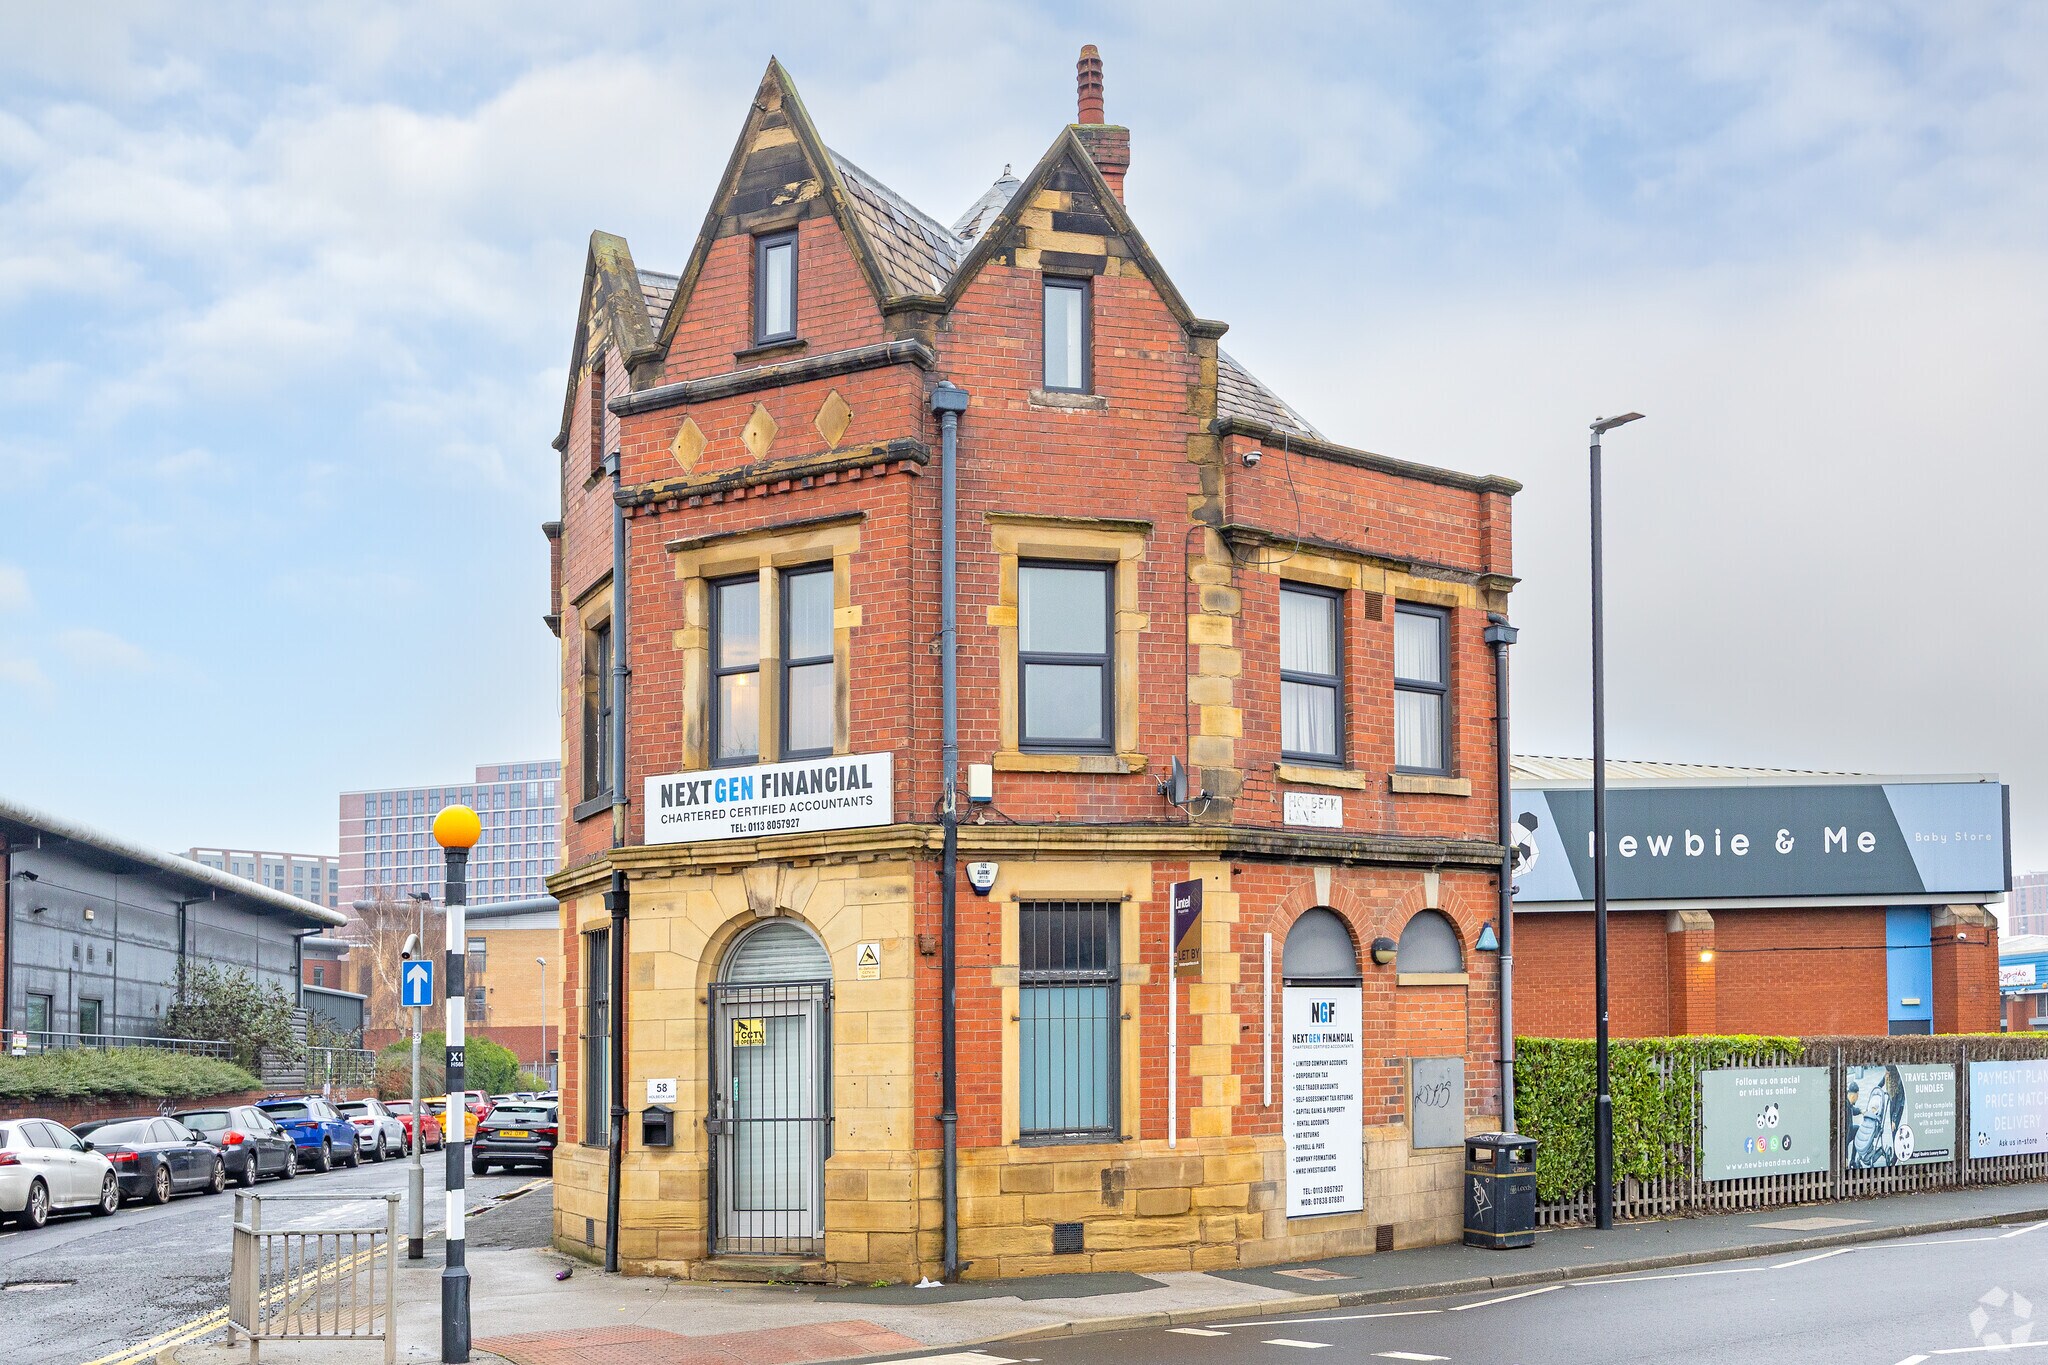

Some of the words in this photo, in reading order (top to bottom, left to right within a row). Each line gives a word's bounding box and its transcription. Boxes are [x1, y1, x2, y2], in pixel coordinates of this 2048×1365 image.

[661, 775, 753, 808] NEXTGEN
[761, 764, 872, 798] FINANCIAL
[661, 811, 726, 824] CHARTERED
[729, 804, 786, 818] CERTIFIED
[789, 796, 873, 813] ACCOUNTANTS
[731, 824, 746, 834] TEL:
[748, 822, 766, 832] 0113
[766, 818, 800, 830] 8057927
[1774, 828, 1795, 855] &
[1824, 826, 1876, 854] Me
[1914, 832, 1948, 844] Baby
[1954, 830, 1992, 842] Store
[1176, 896, 1190, 910] Lintel
[1178, 950, 1189, 960] LET
[1191, 948, 1200, 959] BY
[1312, 1002, 1335, 1023] NGF
[741, 1031, 764, 1039] CCTV
[1292, 1034, 1320, 1043] NEXTGEN
[1322, 1033, 1354, 1042] FINANCIAL
[450, 1052, 463, 1061] X1
[1735, 1076, 1758, 1086] Follow
[1780, 1075, 1800, 1084] social
[1905, 1072, 1928, 1082] TRAVEL
[1929, 1070, 1954, 1081] SYSTEM
[1978, 1070, 2022, 1086] PAYMENT
[656, 1084, 667, 1092] 58
[1749, 1088, 1764, 1096] visit
[1915, 1084, 1944, 1093] BUNDLES
[1986, 1093, 2014, 1108] PRICE
[2018, 1092, 2048, 1106] MATCH
[1995, 1114, 2042, 1131] DELIVERY
[1999, 1139, 2008, 1147] Ask
[2017, 1137, 2037, 1145] in-store
[1726, 1156, 1810, 1170] www.newbieandme.co.uk
